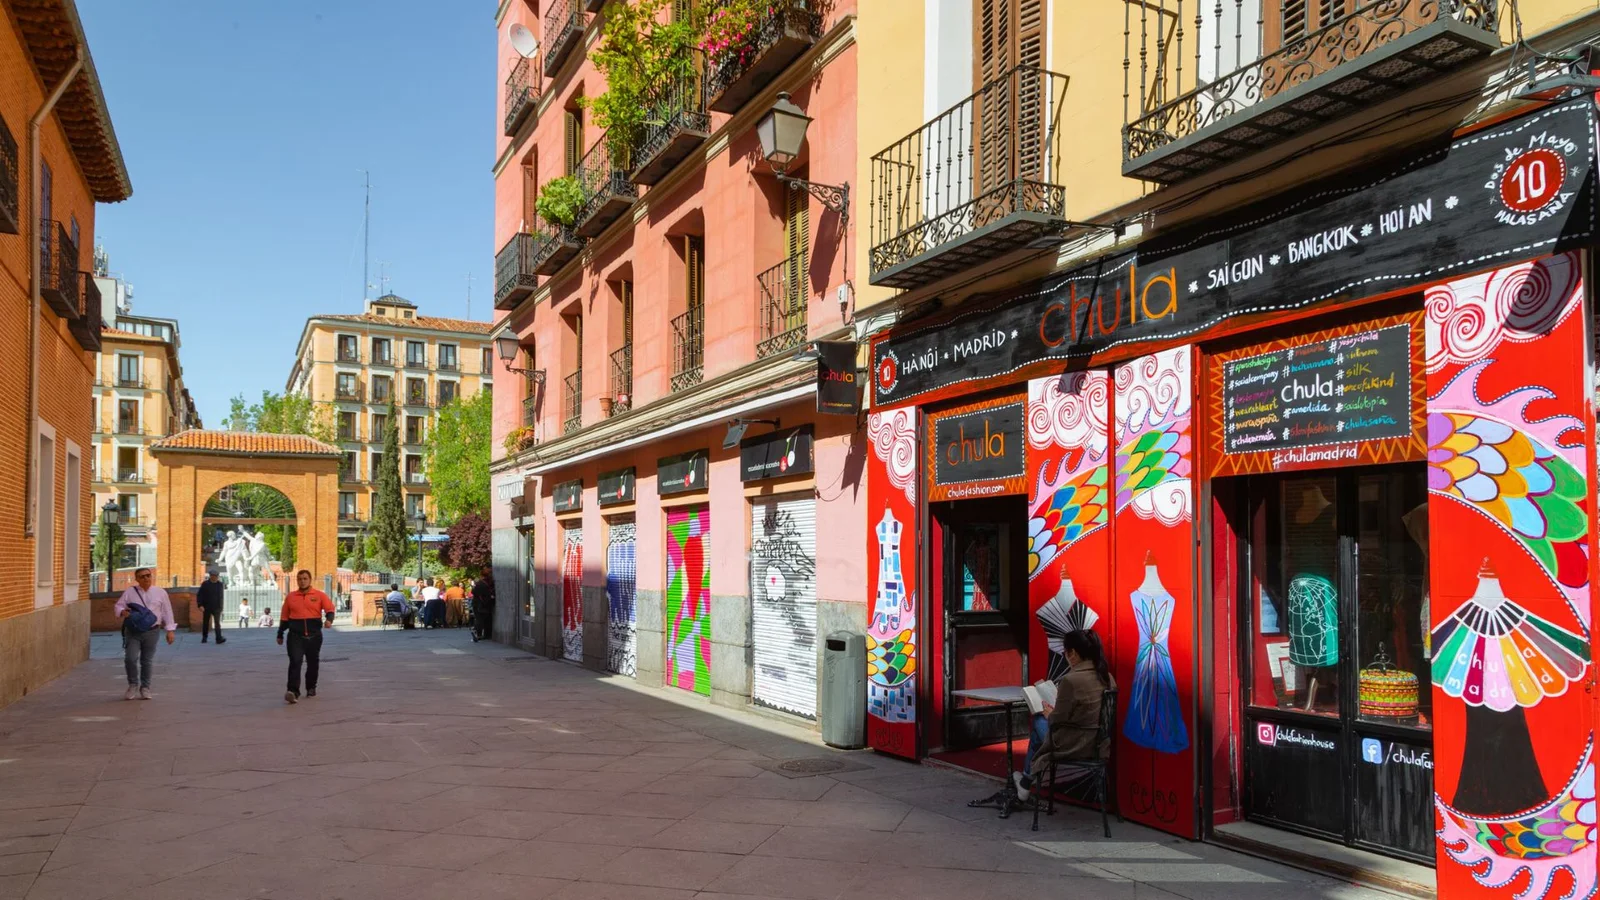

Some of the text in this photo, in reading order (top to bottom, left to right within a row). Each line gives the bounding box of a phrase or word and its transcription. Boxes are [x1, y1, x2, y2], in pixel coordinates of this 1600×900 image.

[1505, 148, 1523, 161] de
[1528, 131, 1576, 155] Mayo
[1511, 160, 1546, 203] 10
[1494, 191, 1575, 226] MALASAÑA
[1040, 264, 1177, 348] chula
[1288, 224, 1359, 263] BANGKOK
[821, 368, 854, 383] chula
[883, 365, 891, 382] 10
[1228, 371, 1279, 391] #socialcompany
[1281, 373, 1333, 402] chula
[1283, 400, 1331, 419] #amedida
[947, 419, 1005, 466] chula
[1272, 443, 1358, 470] #chulamadrid
